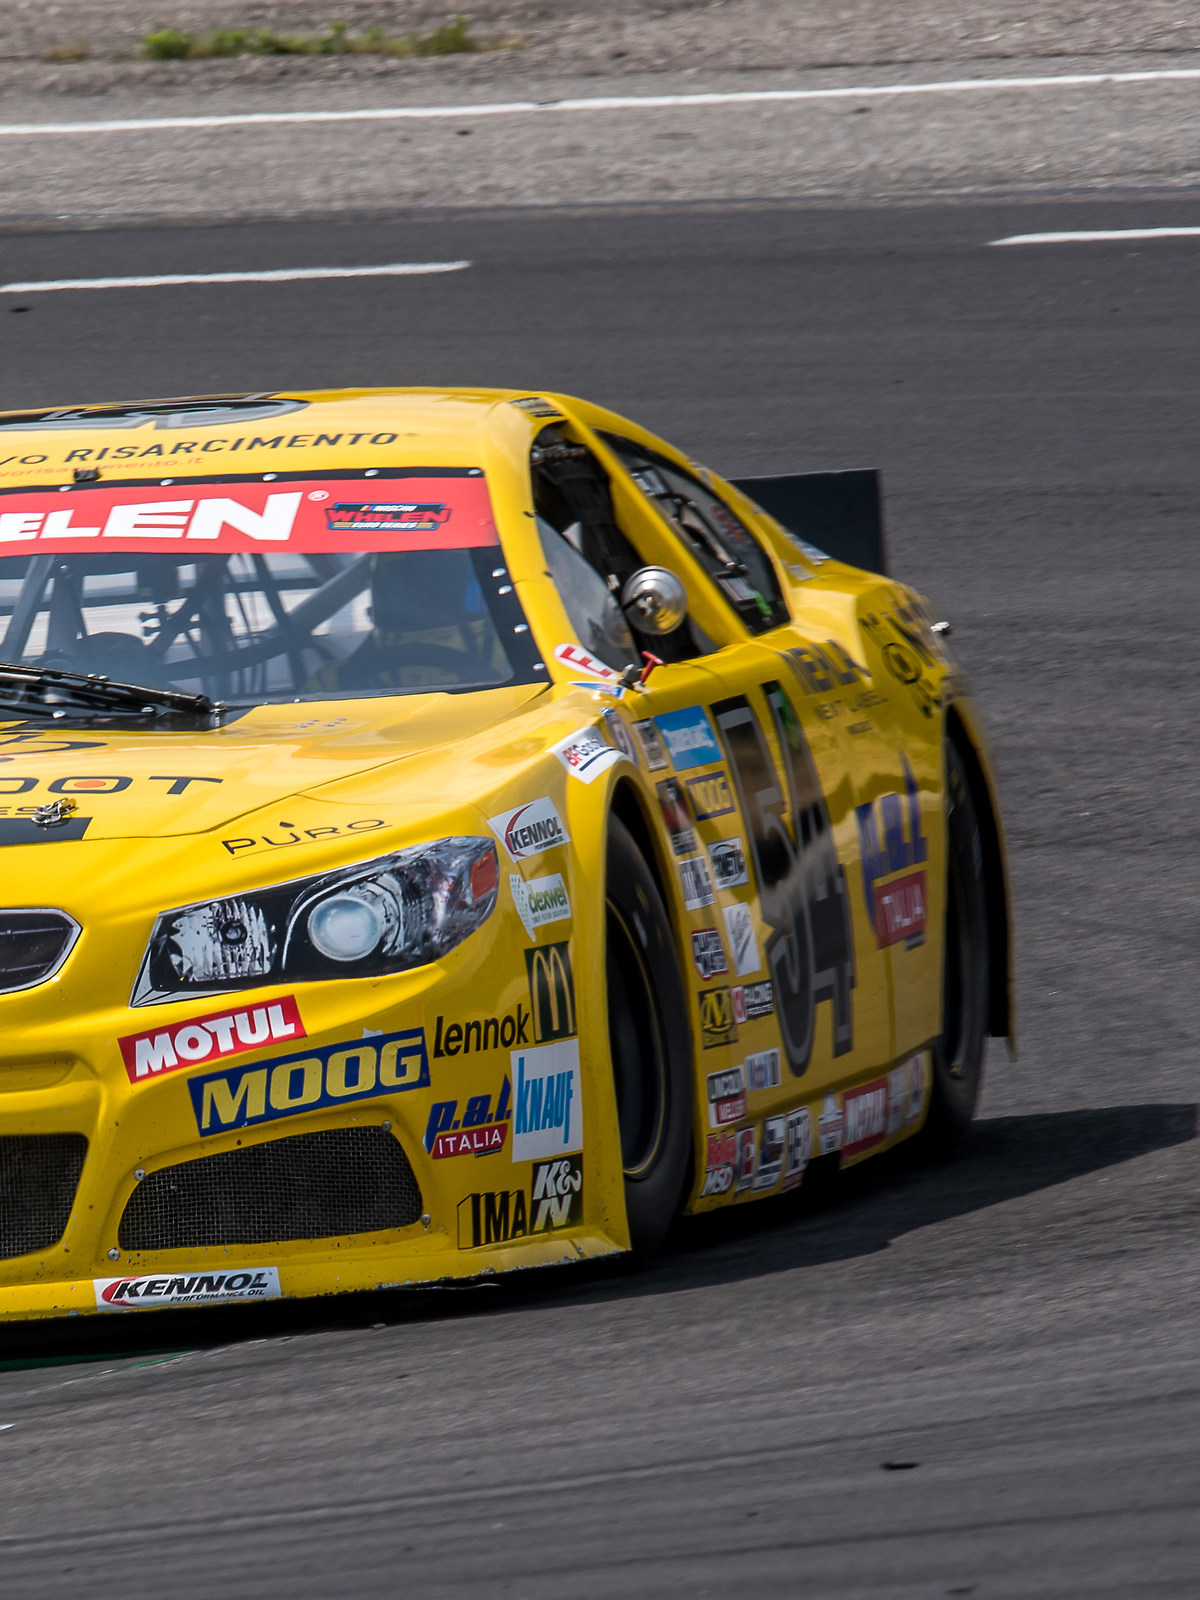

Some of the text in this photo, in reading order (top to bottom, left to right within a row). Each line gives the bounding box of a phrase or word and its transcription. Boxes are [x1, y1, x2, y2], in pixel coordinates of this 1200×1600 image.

[64, 433, 398, 463] RISARCIMENTO
[327, 508, 449, 523] WHELEN
[509, 816, 562, 851] KENNOL
[135, 1003, 296, 1078] MOTUL
[201, 1036, 423, 1129] MOOG
[515, 1056, 574, 1144] KNAUF
[438, 1129, 502, 1154] ITALIA
[112, 1272, 268, 1299] KENNOL
[170, 1290, 246, 1302] PERFORMANCE
